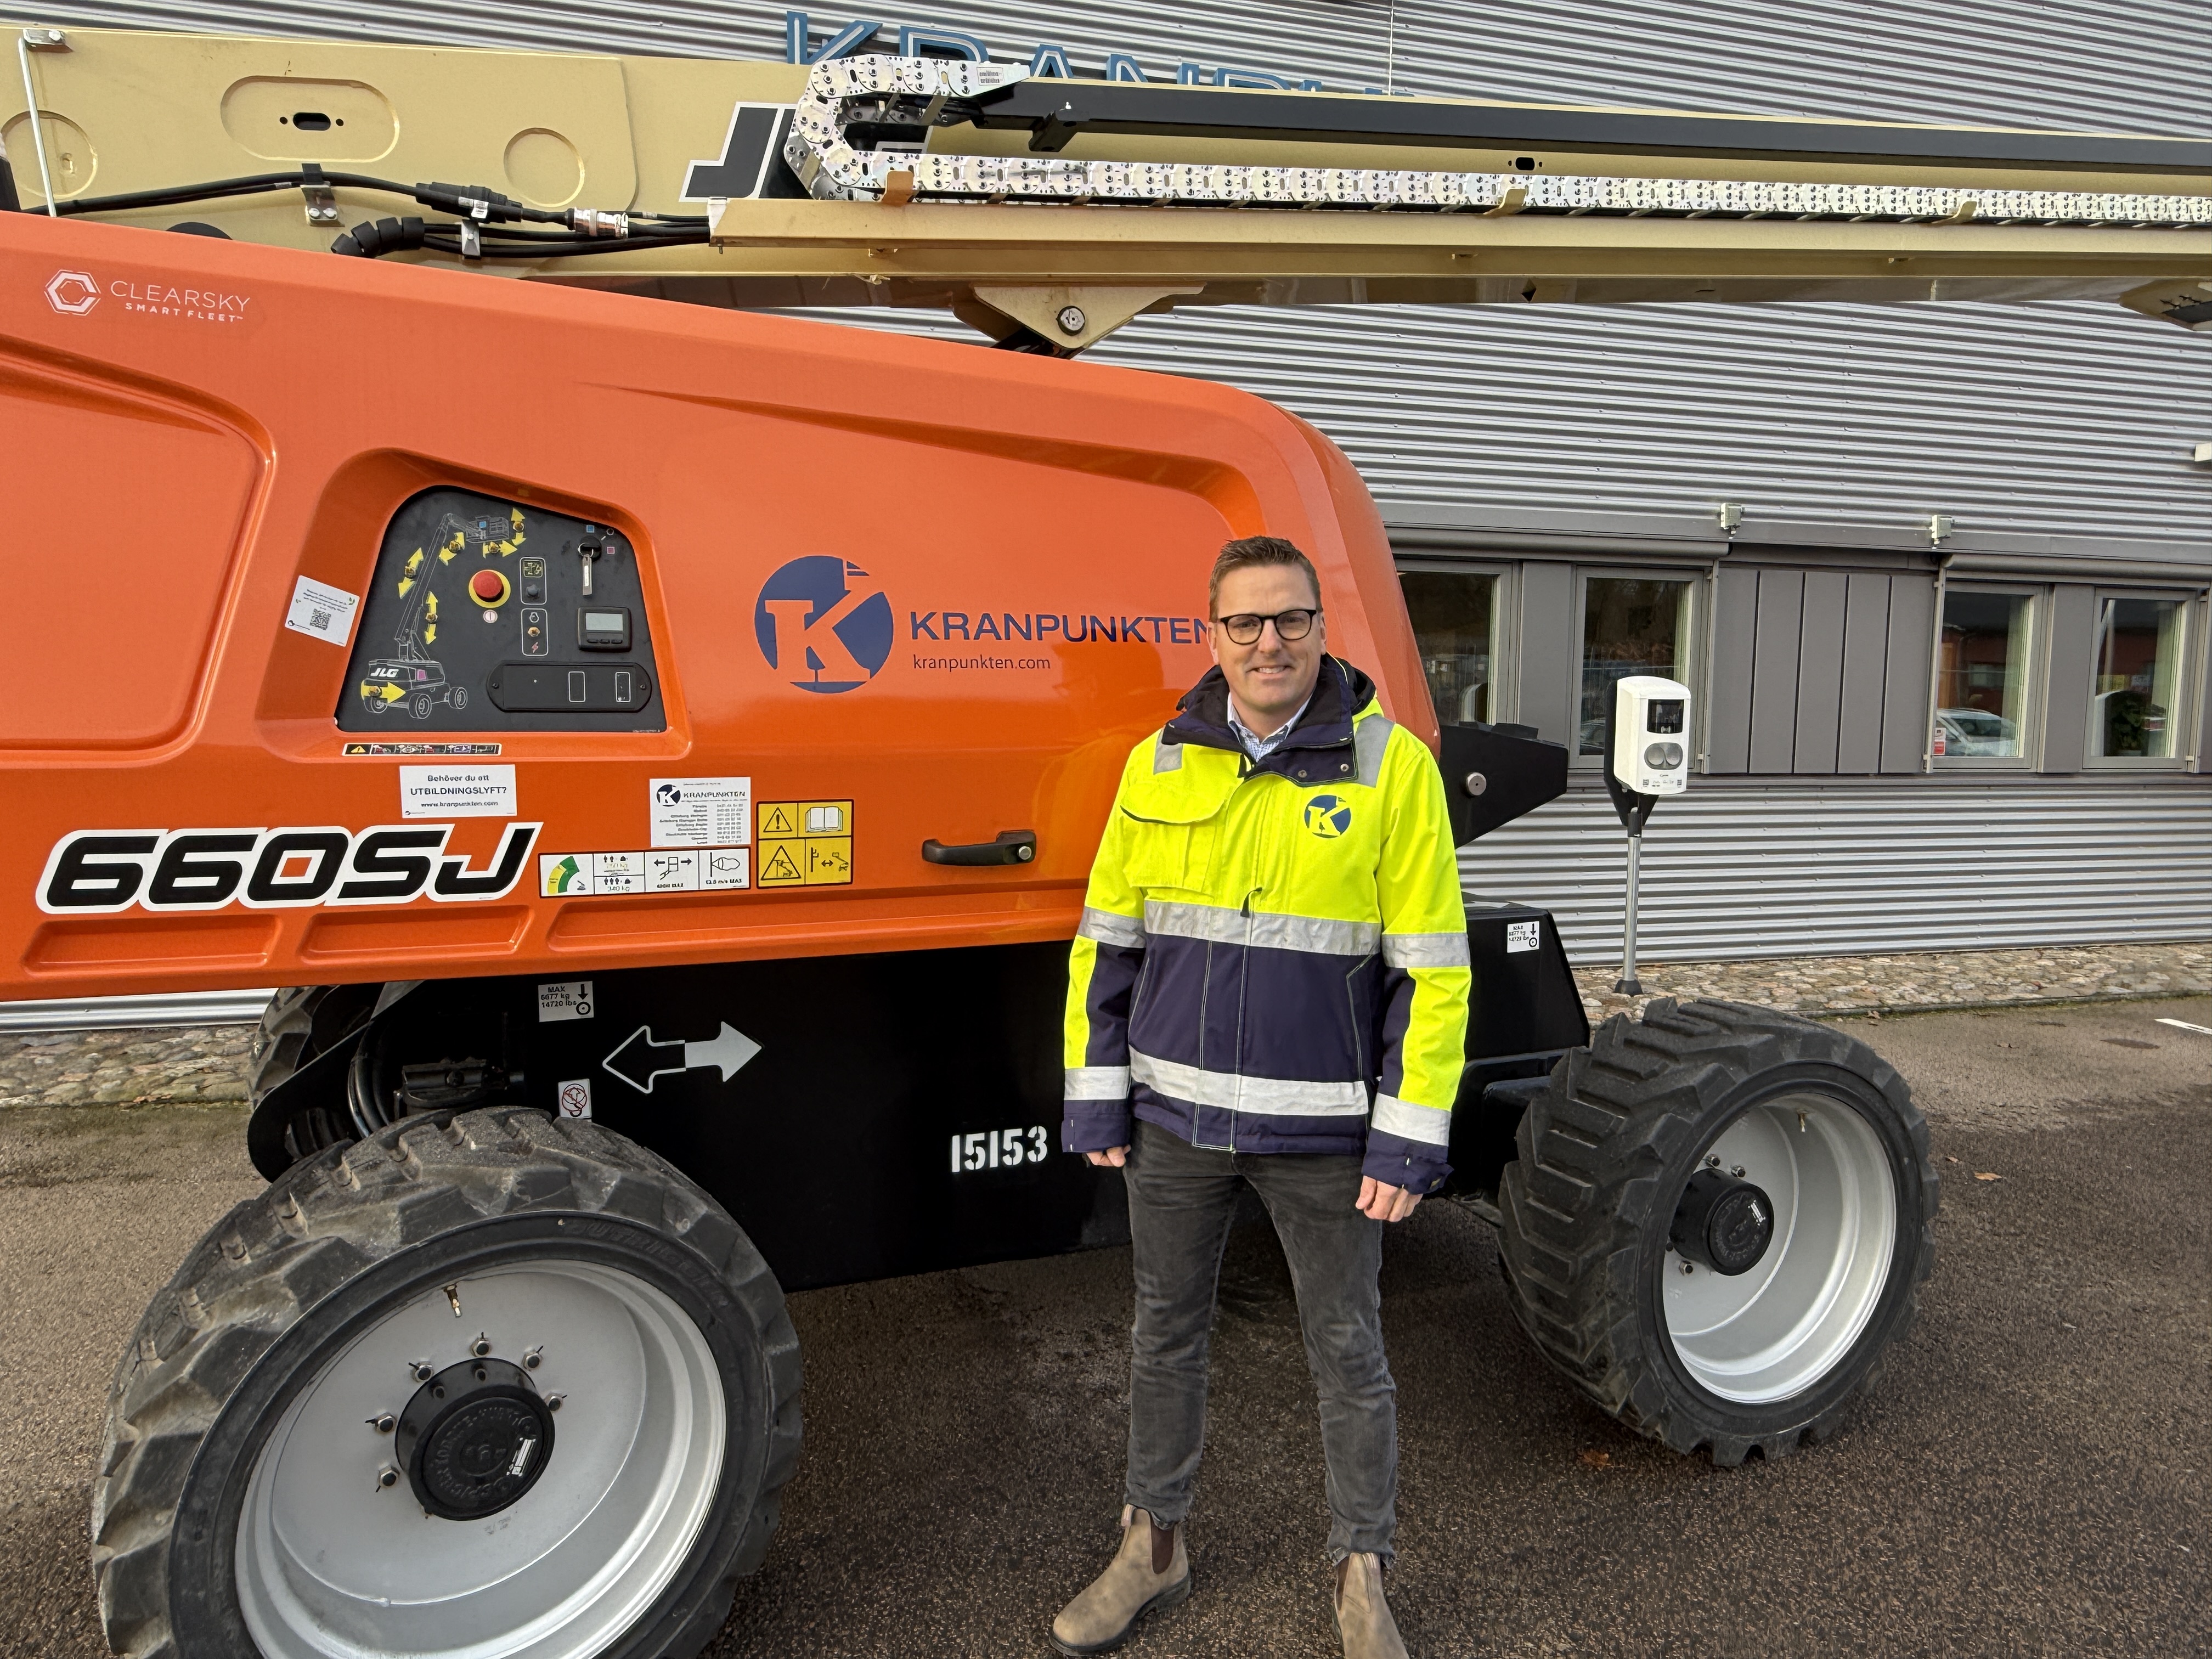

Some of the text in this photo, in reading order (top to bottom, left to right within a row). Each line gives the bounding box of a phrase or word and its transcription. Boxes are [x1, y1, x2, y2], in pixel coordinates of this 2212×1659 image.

[110, 280, 250, 312] CLEARSKY
[125, 302, 181, 316] SMART
[913, 654, 1051, 672] kranpunkten.com
[370, 667, 399, 678] JLG
[410, 786, 507, 795] UTBILDNINGSLYFT?
[40, 824, 540, 912] 660SJ
[951, 1125, 1048, 1173] 15153
